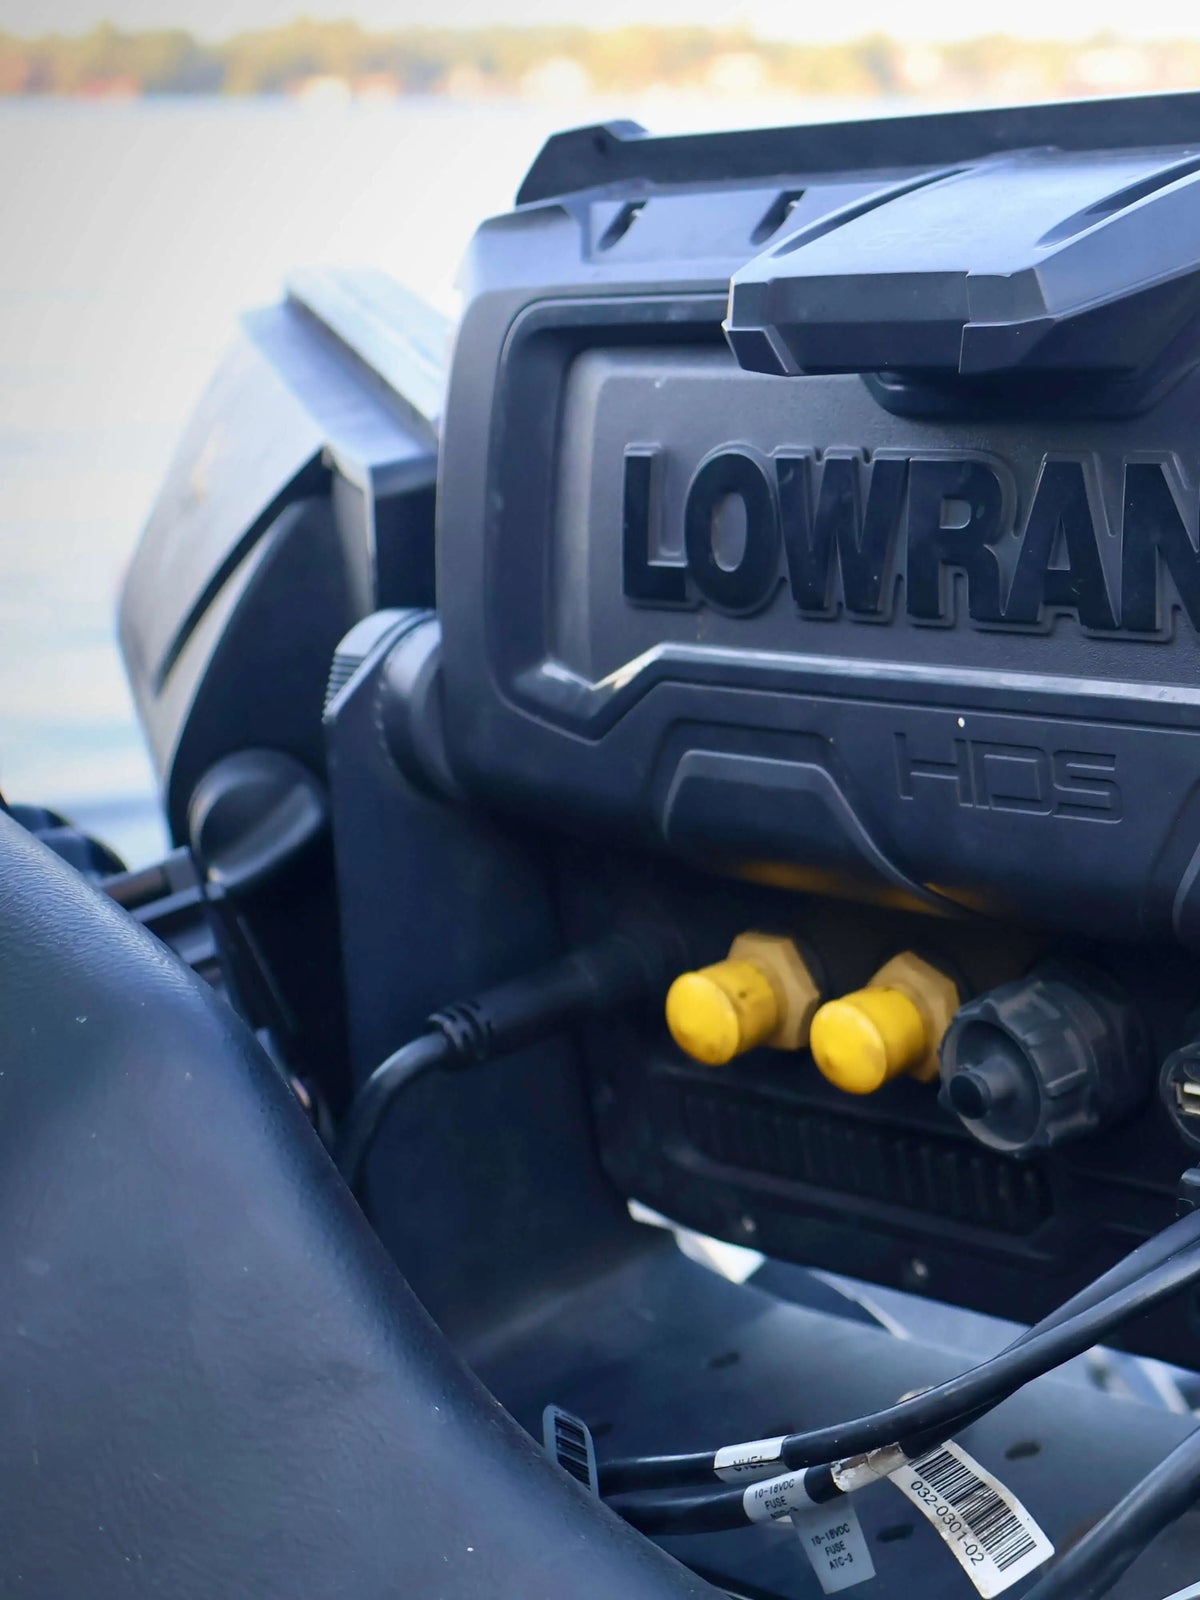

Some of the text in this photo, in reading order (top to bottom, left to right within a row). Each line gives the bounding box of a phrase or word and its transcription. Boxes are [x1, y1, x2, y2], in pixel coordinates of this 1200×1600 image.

[893, 731, 1124, 825] HDS
[754, 1478, 796, 1499] 10-18VDC
[764, 1495, 788, 1510] FUSE
[810, 1522, 850, 1547] 10-18VDC
[910, 1480, 985, 1567] 032-0301-02
[824, 1541, 847, 1557] FUSE
